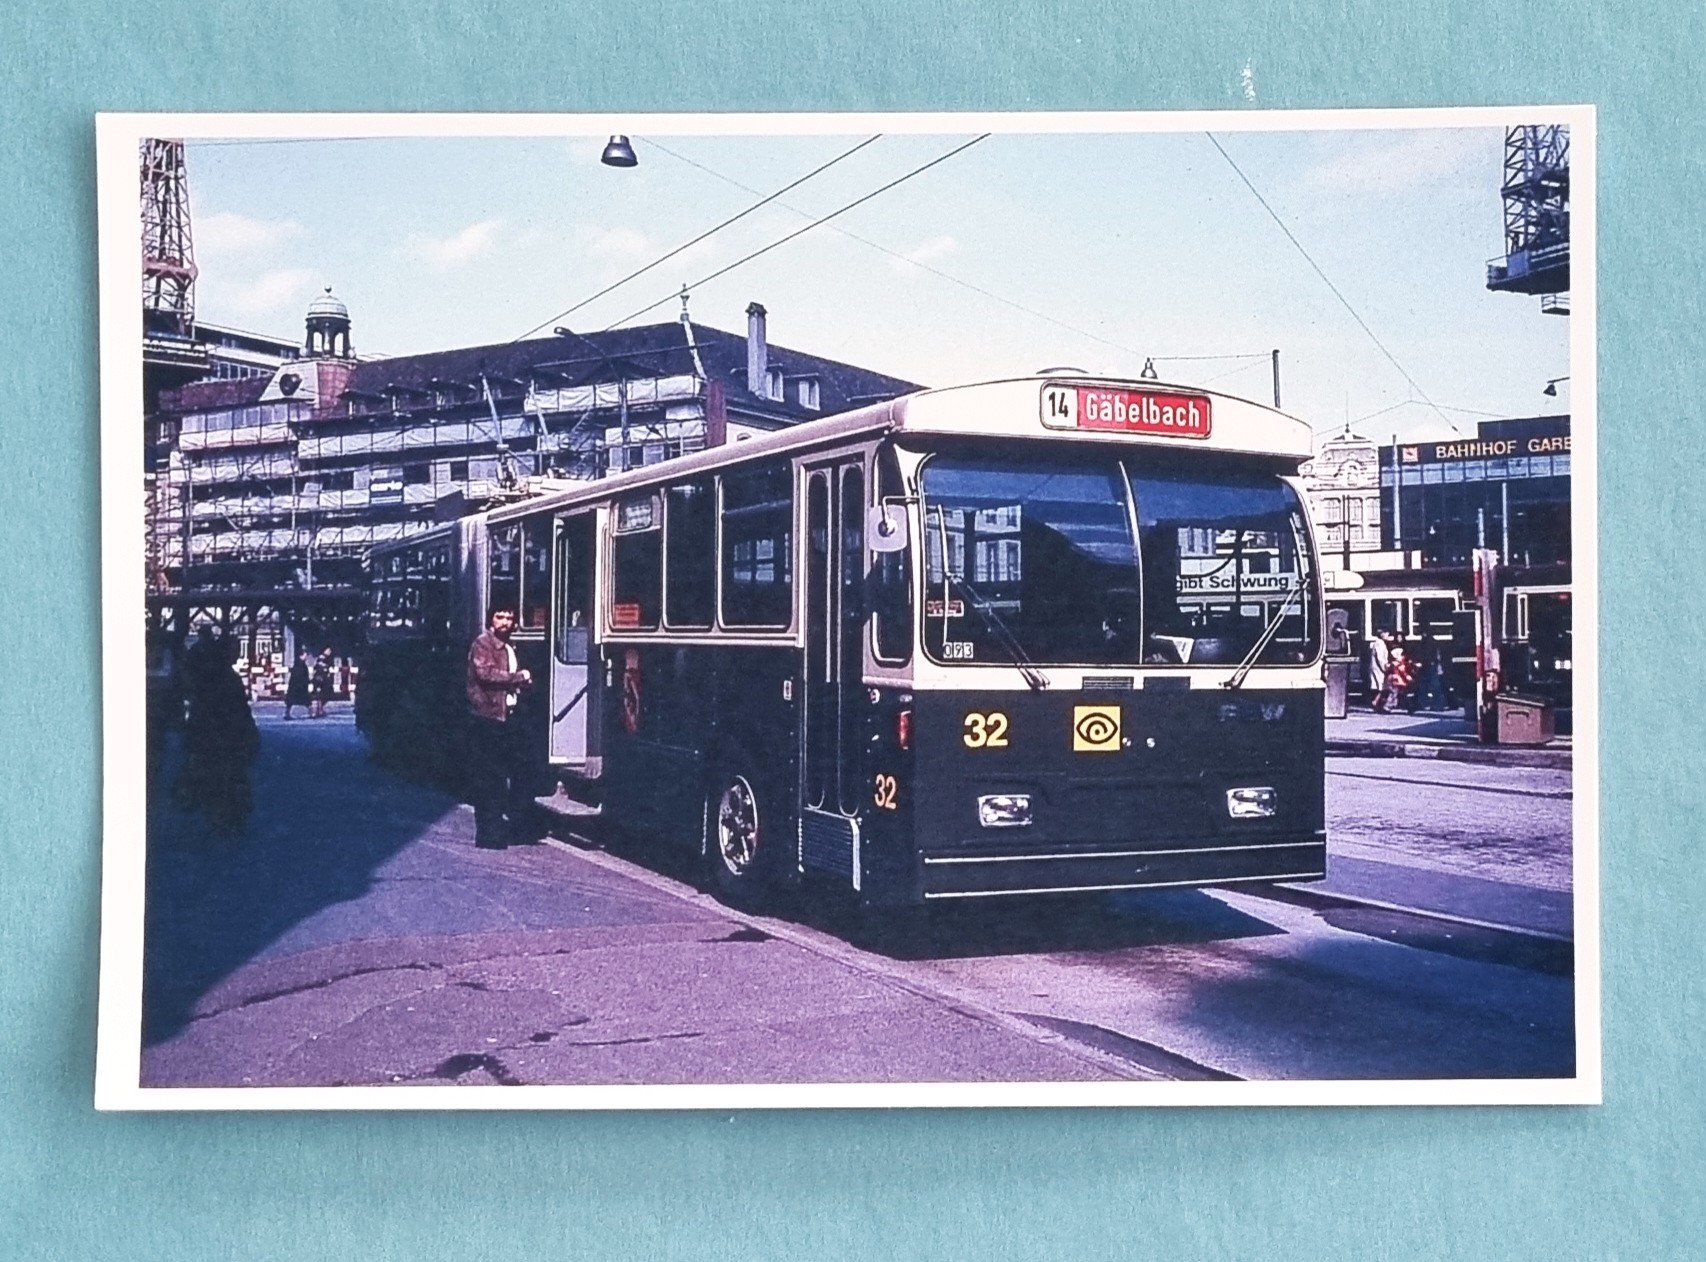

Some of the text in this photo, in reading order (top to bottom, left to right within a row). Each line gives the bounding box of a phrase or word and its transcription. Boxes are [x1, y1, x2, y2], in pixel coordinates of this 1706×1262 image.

[1048, 391, 1200, 428] 14 Gäbelbach
[1436, 440, 1517, 459] BAHNHOF
[943, 643, 973, 657] 093
[963, 713, 1009, 748] 32
[874, 773, 898, 810] 32
